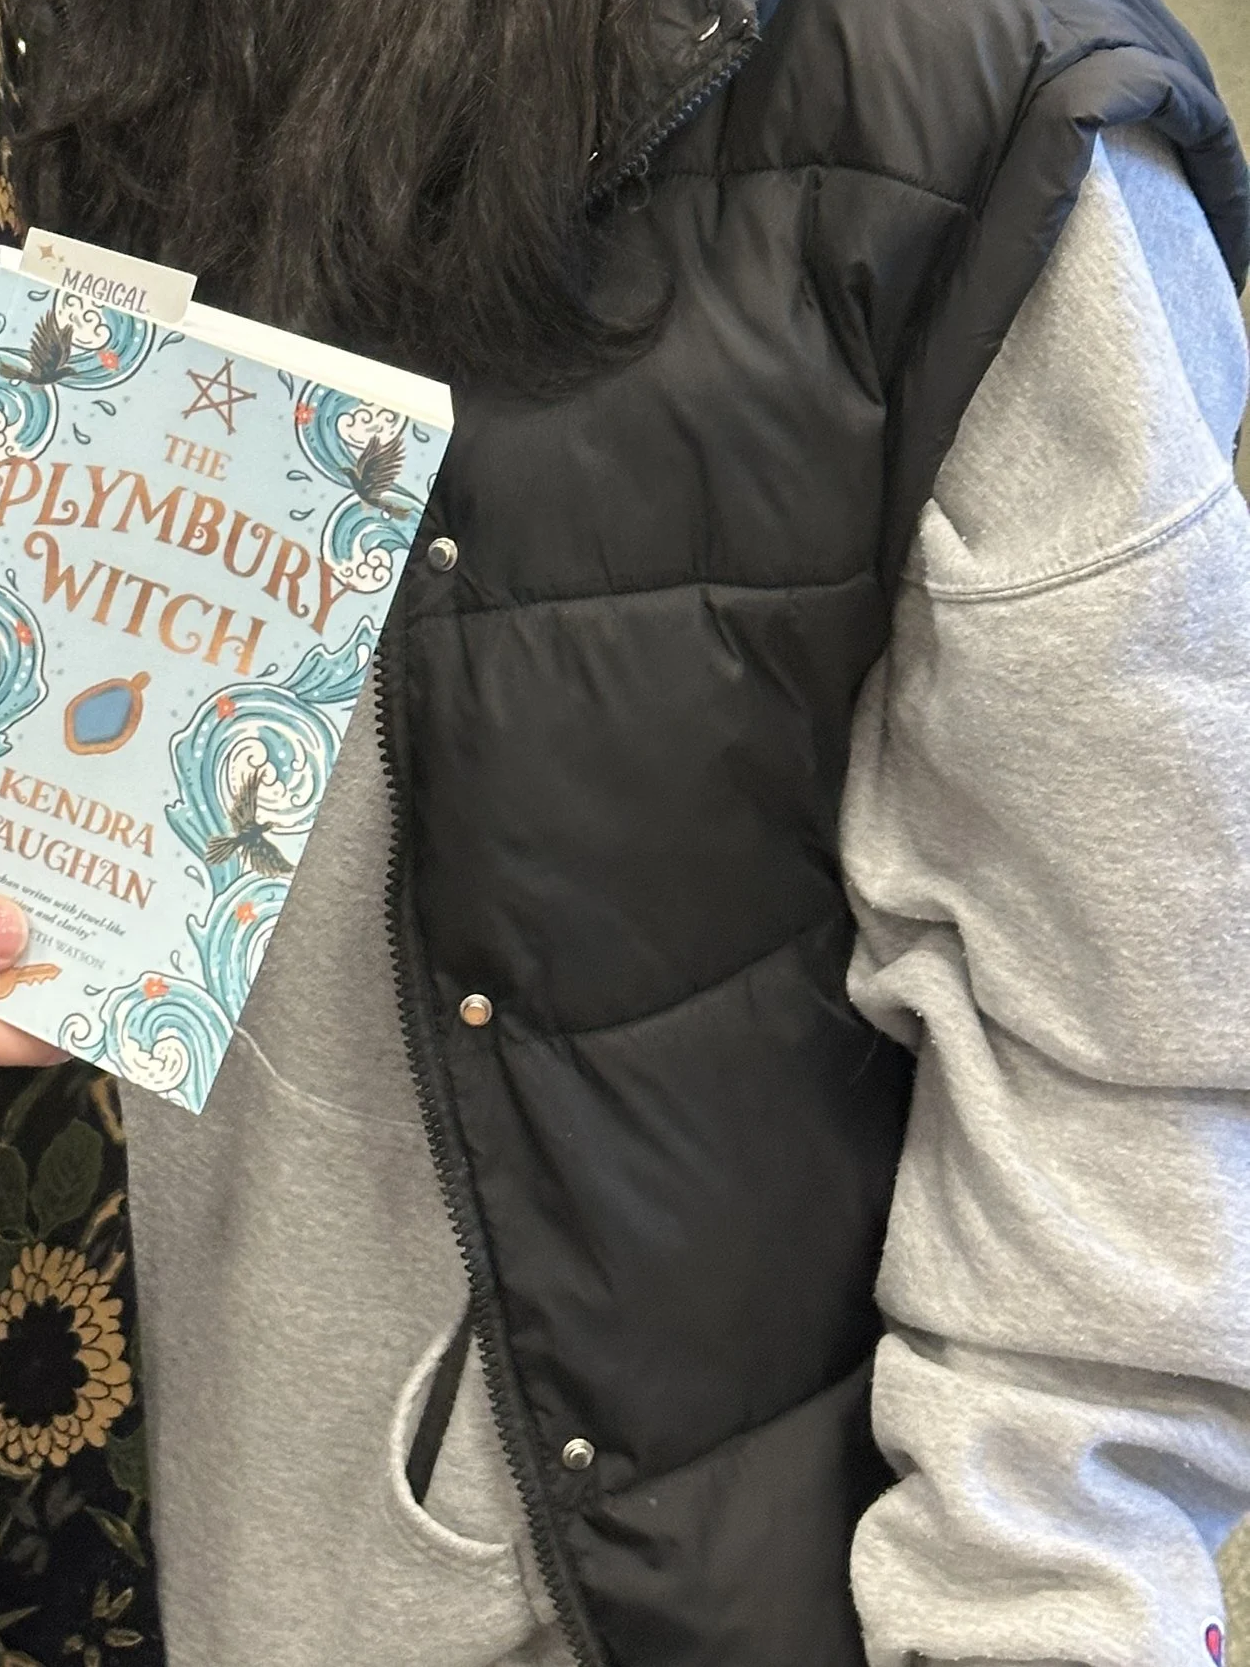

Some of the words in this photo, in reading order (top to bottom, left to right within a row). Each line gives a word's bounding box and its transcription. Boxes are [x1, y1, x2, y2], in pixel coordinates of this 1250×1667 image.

[164, 433, 233, 482] THE
[24, 530, 267, 676] WITCH
[22, 885, 53, 904] writes
[53, 899, 78, 916] with
[75, 909, 127, 937] jewel-like
[35, 909, 59, 925] and
[56, 939, 107, 971] WATSON
